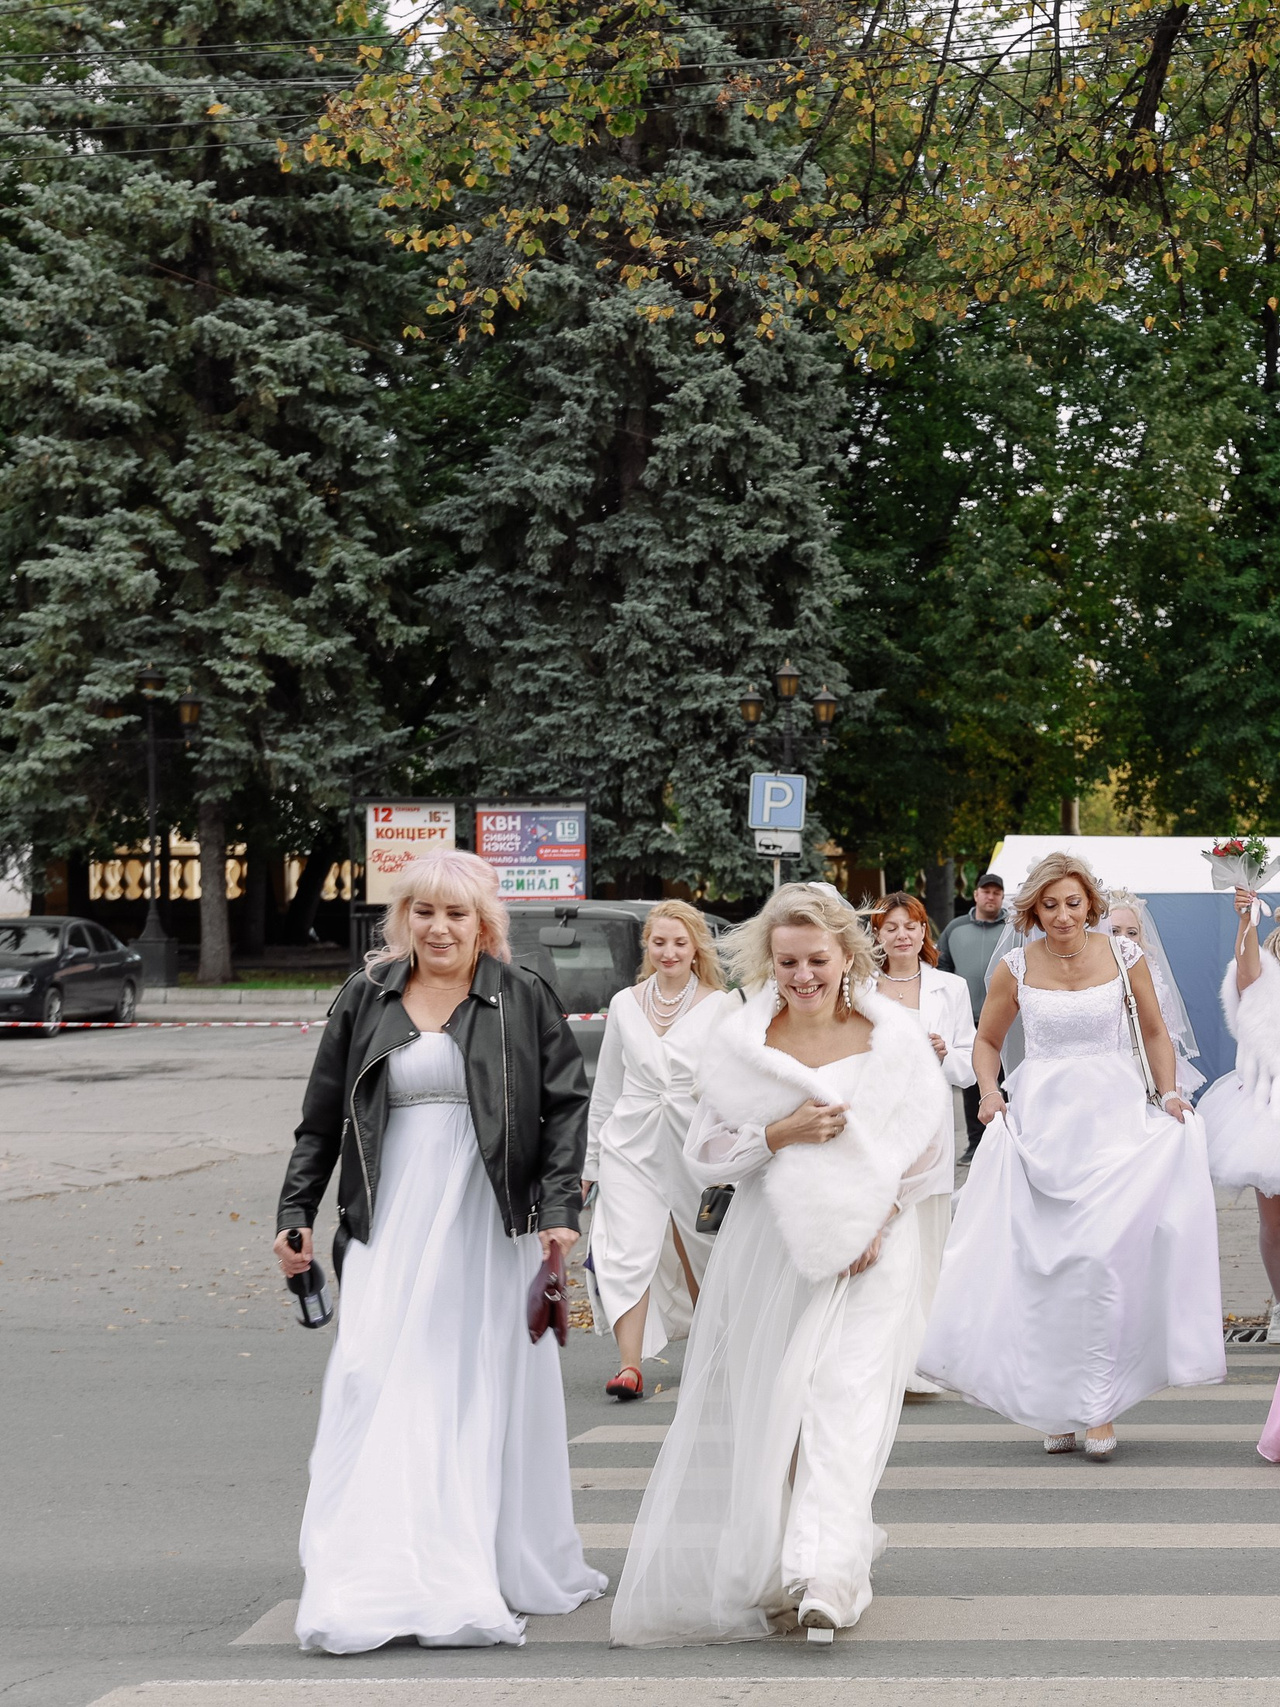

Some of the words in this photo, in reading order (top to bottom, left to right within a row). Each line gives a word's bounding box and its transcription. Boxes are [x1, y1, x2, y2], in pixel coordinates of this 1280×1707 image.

[762, 780, 794, 823] P
[373, 807, 393, 822] 12
[482, 815, 521, 831] КВН
[560, 822, 576, 835] 19
[375, 827, 447, 841] КОНЦЕРТ
[482, 833, 521, 842] СИБИРЬ
[482, 842, 521, 852] НЭКСТ
[501, 878, 559, 890] ФИНАЛ
